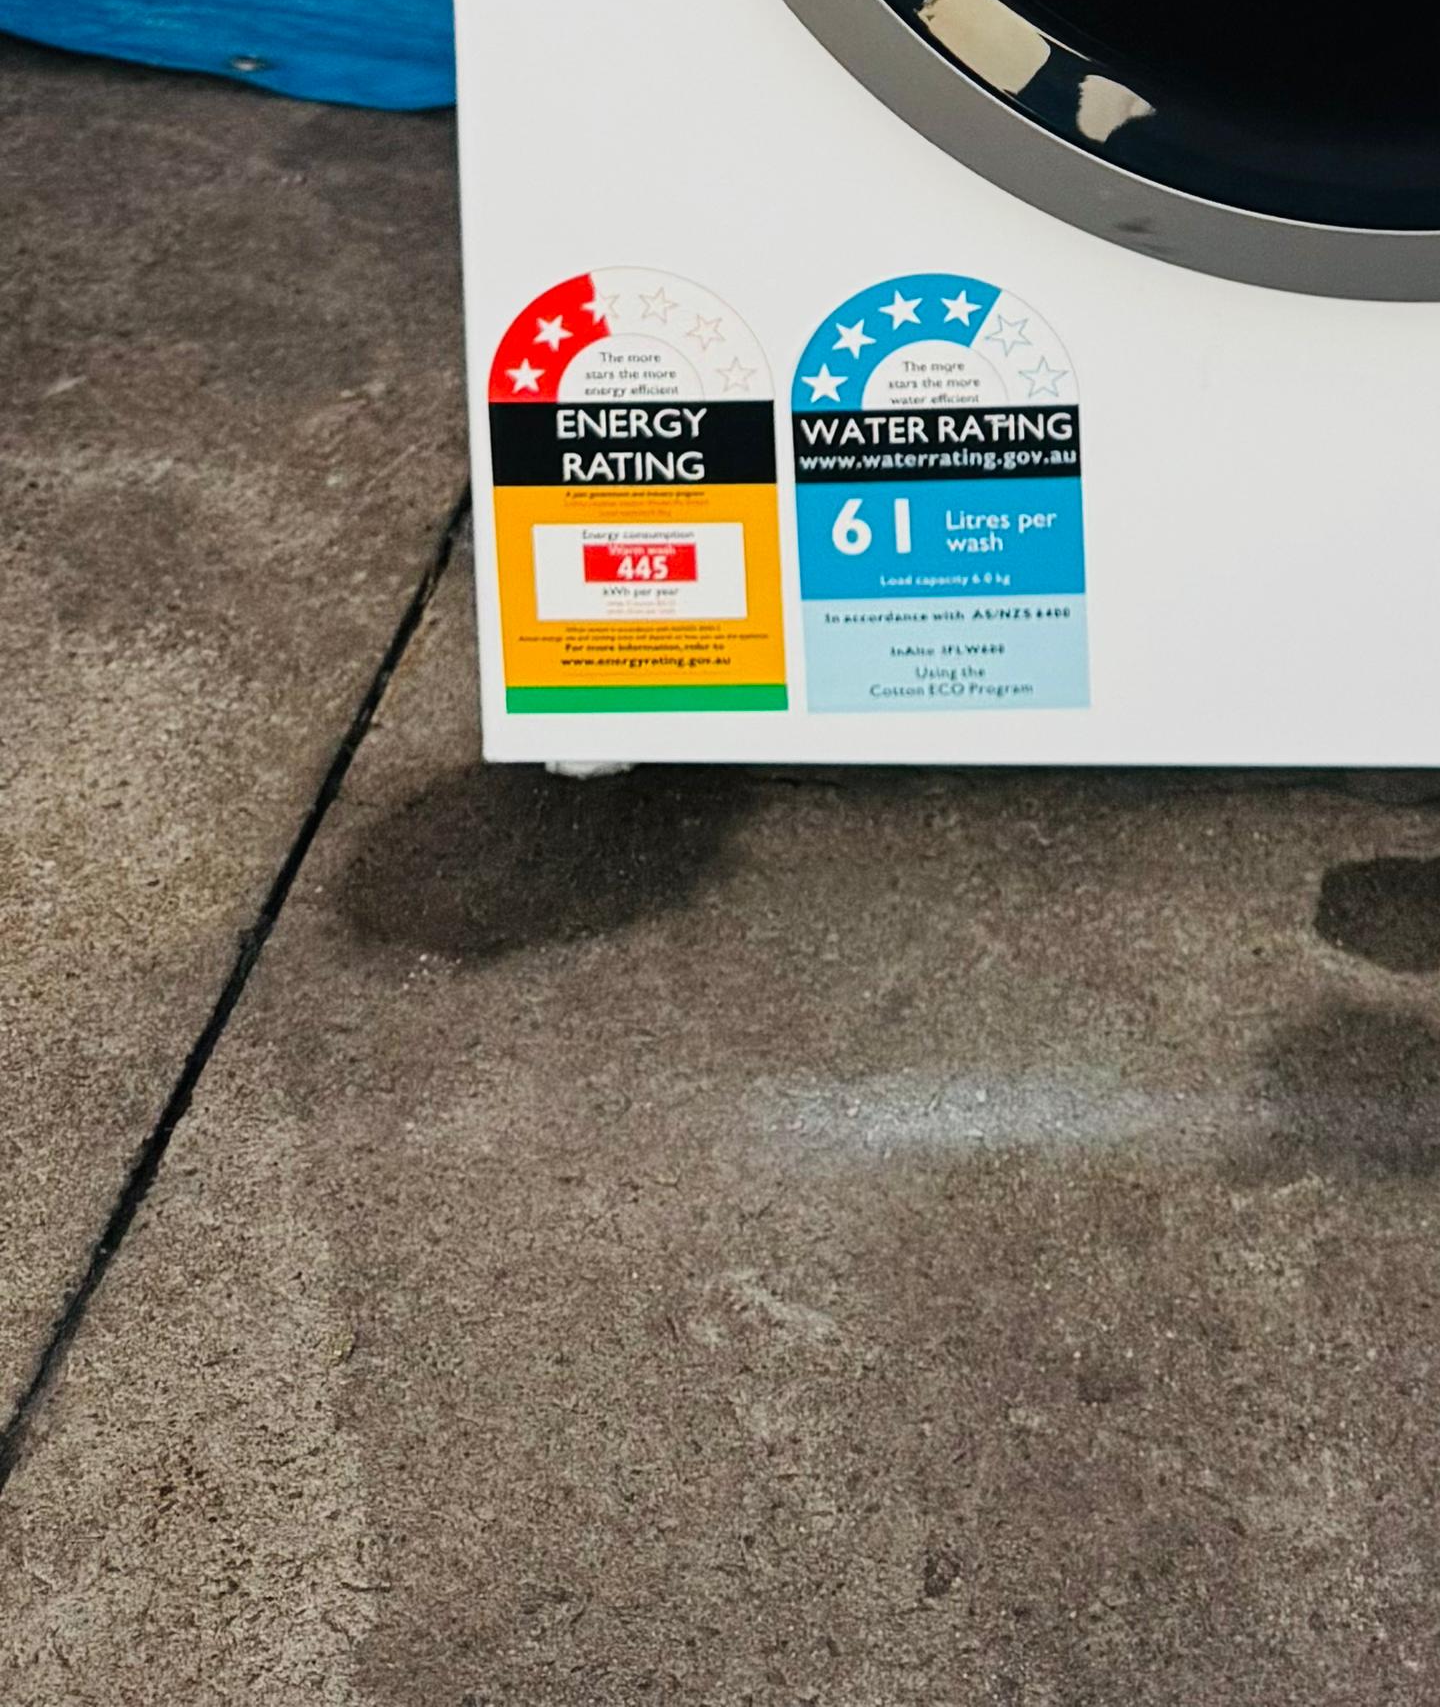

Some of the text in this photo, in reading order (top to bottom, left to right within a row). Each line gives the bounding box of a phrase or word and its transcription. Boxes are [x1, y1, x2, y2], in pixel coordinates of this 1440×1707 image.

[601, 352, 661, 363] The more
[586, 369, 677, 380] stars the more
[902, 361, 965, 373] The more
[889, 377, 980, 389] stars the more
[584, 384, 679, 399] energy efficient
[889, 393, 979, 405] water efficient
[556, 408, 707, 440] ENERGY
[800, 412, 1073, 446] WATER RATING
[561, 451, 705, 482] RATING
[799, 449, 1077, 471] www.waterrating.gov.au
[945, 510, 1056, 533] Litres per
[582, 530, 695, 541] Energy consumption
[946, 532, 1004, 553] wash
[618, 555, 668, 579] 445
[880, 575, 912, 587] Load
[996, 572, 1011, 587] kg
[824, 613, 839, 624] In
[933, 610, 965, 621] with
[915, 666, 986, 680] Using the
[869, 683, 1033, 698] Cotton ECO Program
